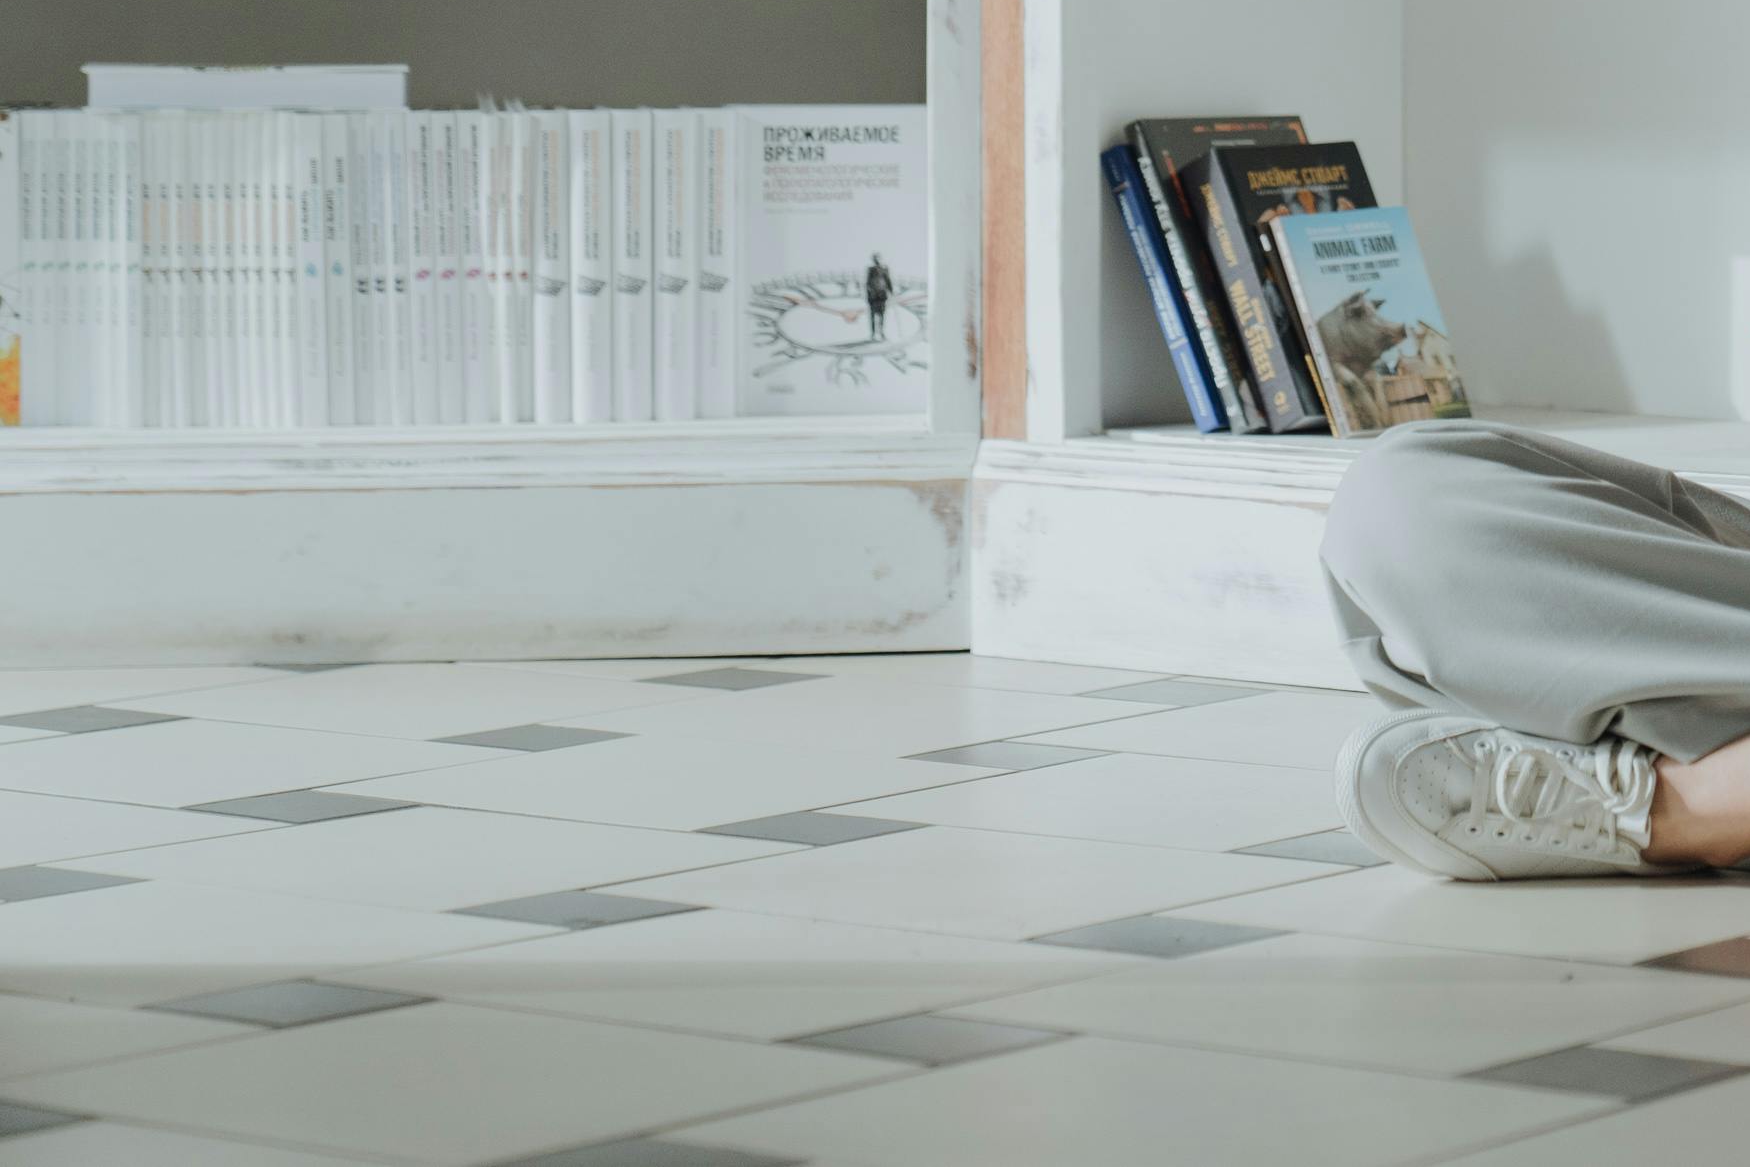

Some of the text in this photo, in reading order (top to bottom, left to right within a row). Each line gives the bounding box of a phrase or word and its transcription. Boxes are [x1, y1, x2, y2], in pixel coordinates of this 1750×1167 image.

[763, 125, 901, 144] ПРОЖИВАЕМОЕ
[763, 145, 826, 162] ВРЕМЯ
[1248, 164, 1350, 191] ДЖЕЙМС СТЮАРТ
[1312, 233, 1398, 260] ANIMAL FARM
[1243, 322, 1277, 381] STREET
